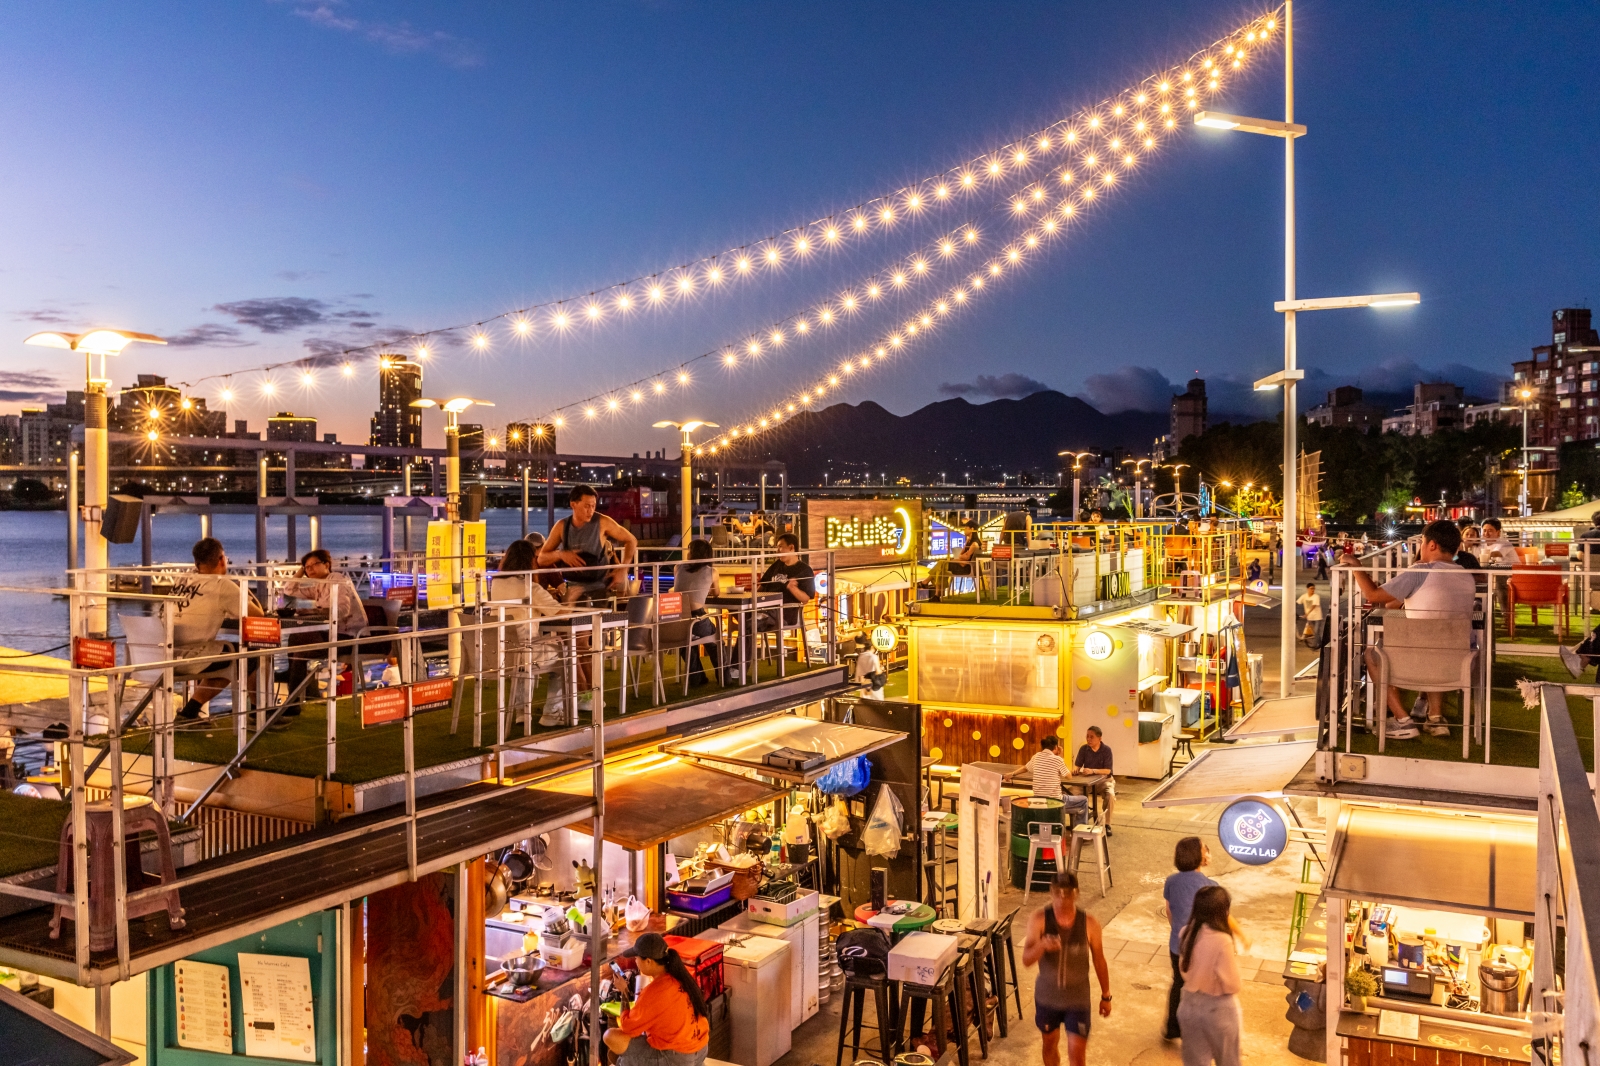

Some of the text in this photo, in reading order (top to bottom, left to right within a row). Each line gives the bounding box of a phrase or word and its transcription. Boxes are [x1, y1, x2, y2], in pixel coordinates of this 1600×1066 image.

[1091, 645, 1106, 655] BOW
[1228, 844, 1277, 858] PIZZA LAB
[1467, 1041, 1510, 1054] LAB
